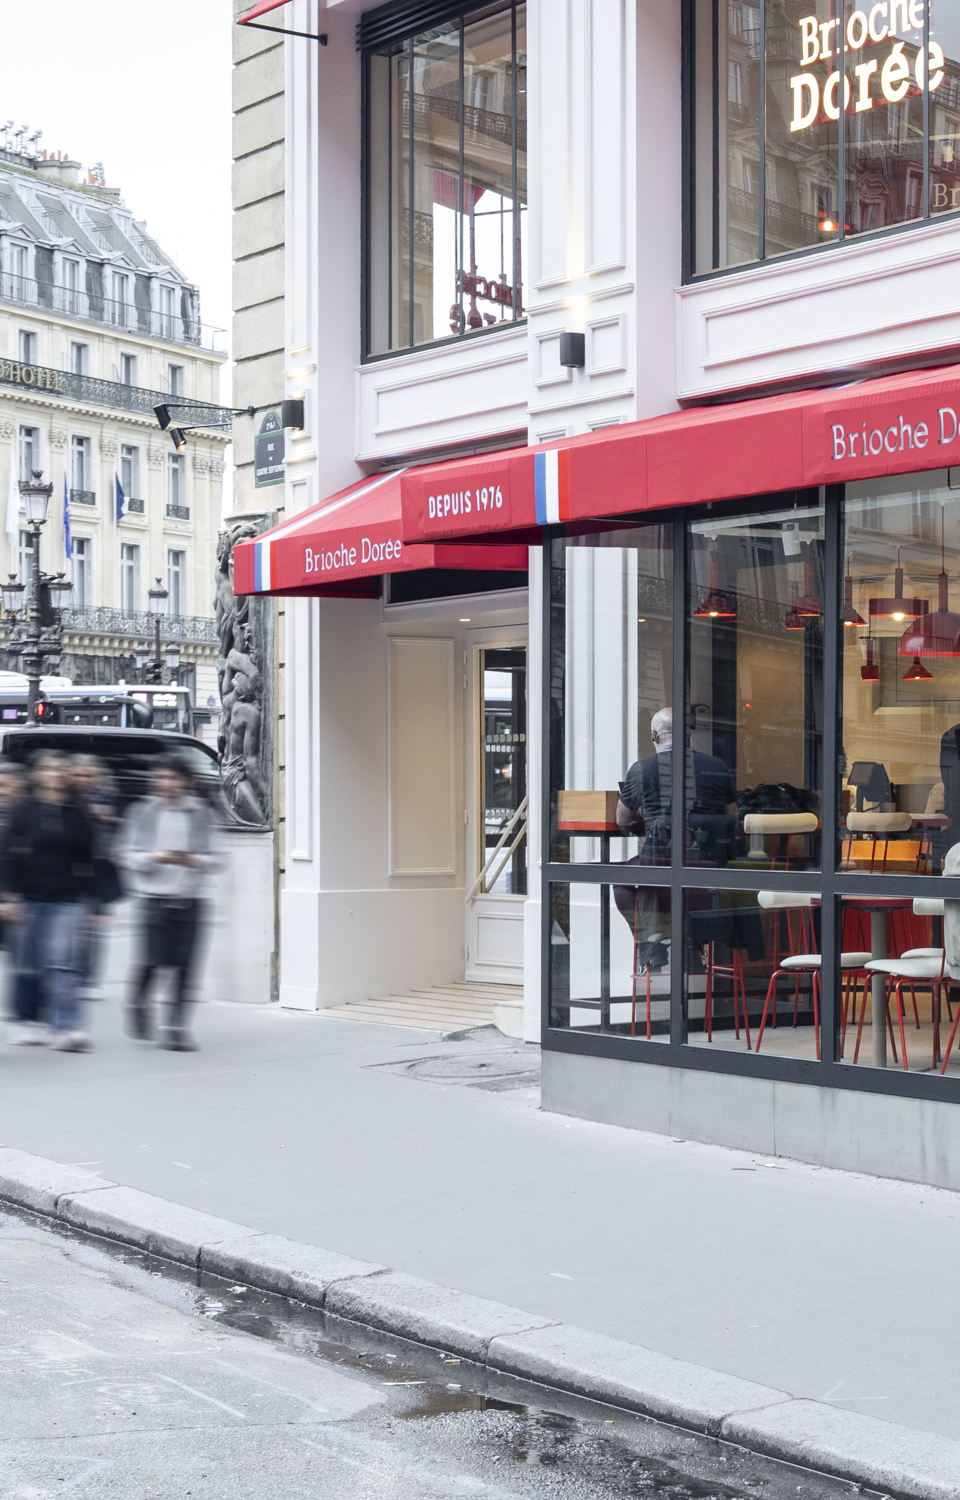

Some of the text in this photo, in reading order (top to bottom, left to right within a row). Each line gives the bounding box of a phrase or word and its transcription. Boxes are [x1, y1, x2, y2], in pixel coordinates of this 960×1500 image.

[789, 40, 945, 133] Dorée
[9, 363, 62, 391] HOTEL
[829, 414, 929, 460] Brioche
[428, 485, 503, 519] DEPUIS 1976
[304, 537, 402, 573] Brioche Dorée
